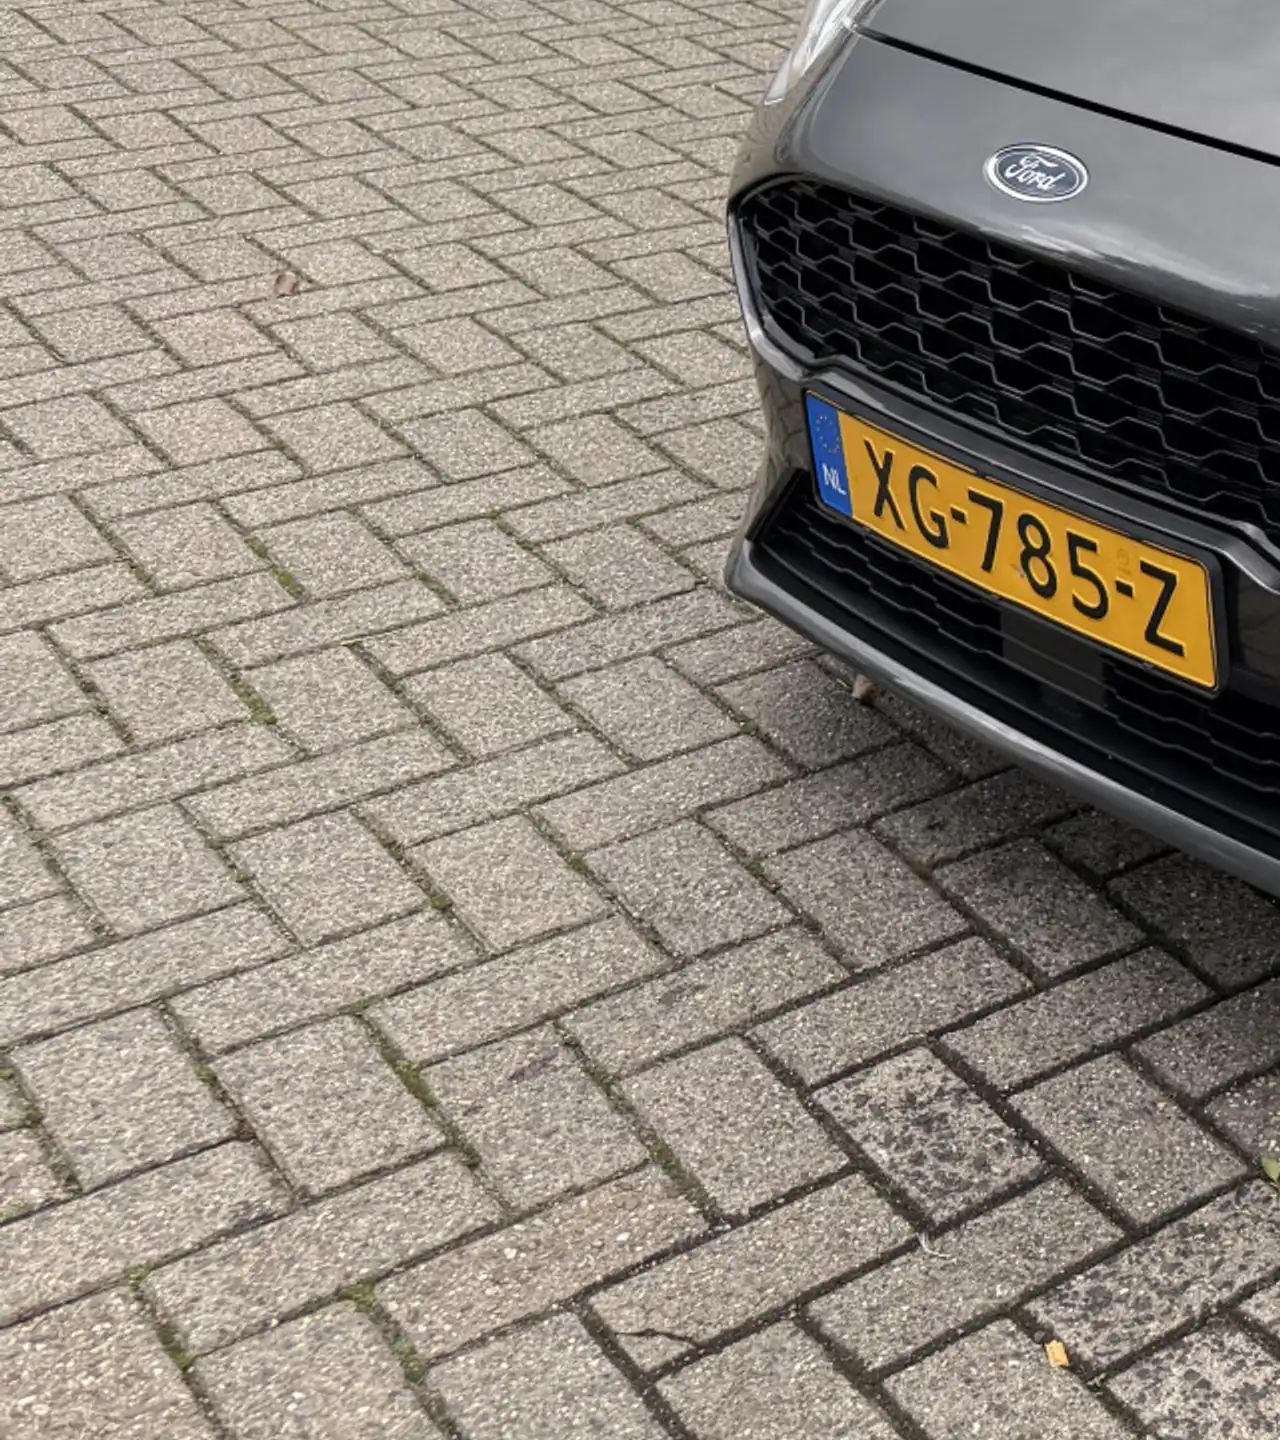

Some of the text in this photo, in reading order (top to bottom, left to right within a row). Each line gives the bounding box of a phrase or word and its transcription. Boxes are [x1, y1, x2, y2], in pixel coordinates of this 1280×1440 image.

[1004, 155, 1066, 191] Ford
[822, 464, 847, 496] NL
[863, 437, 1187, 658] XG-785-Z
